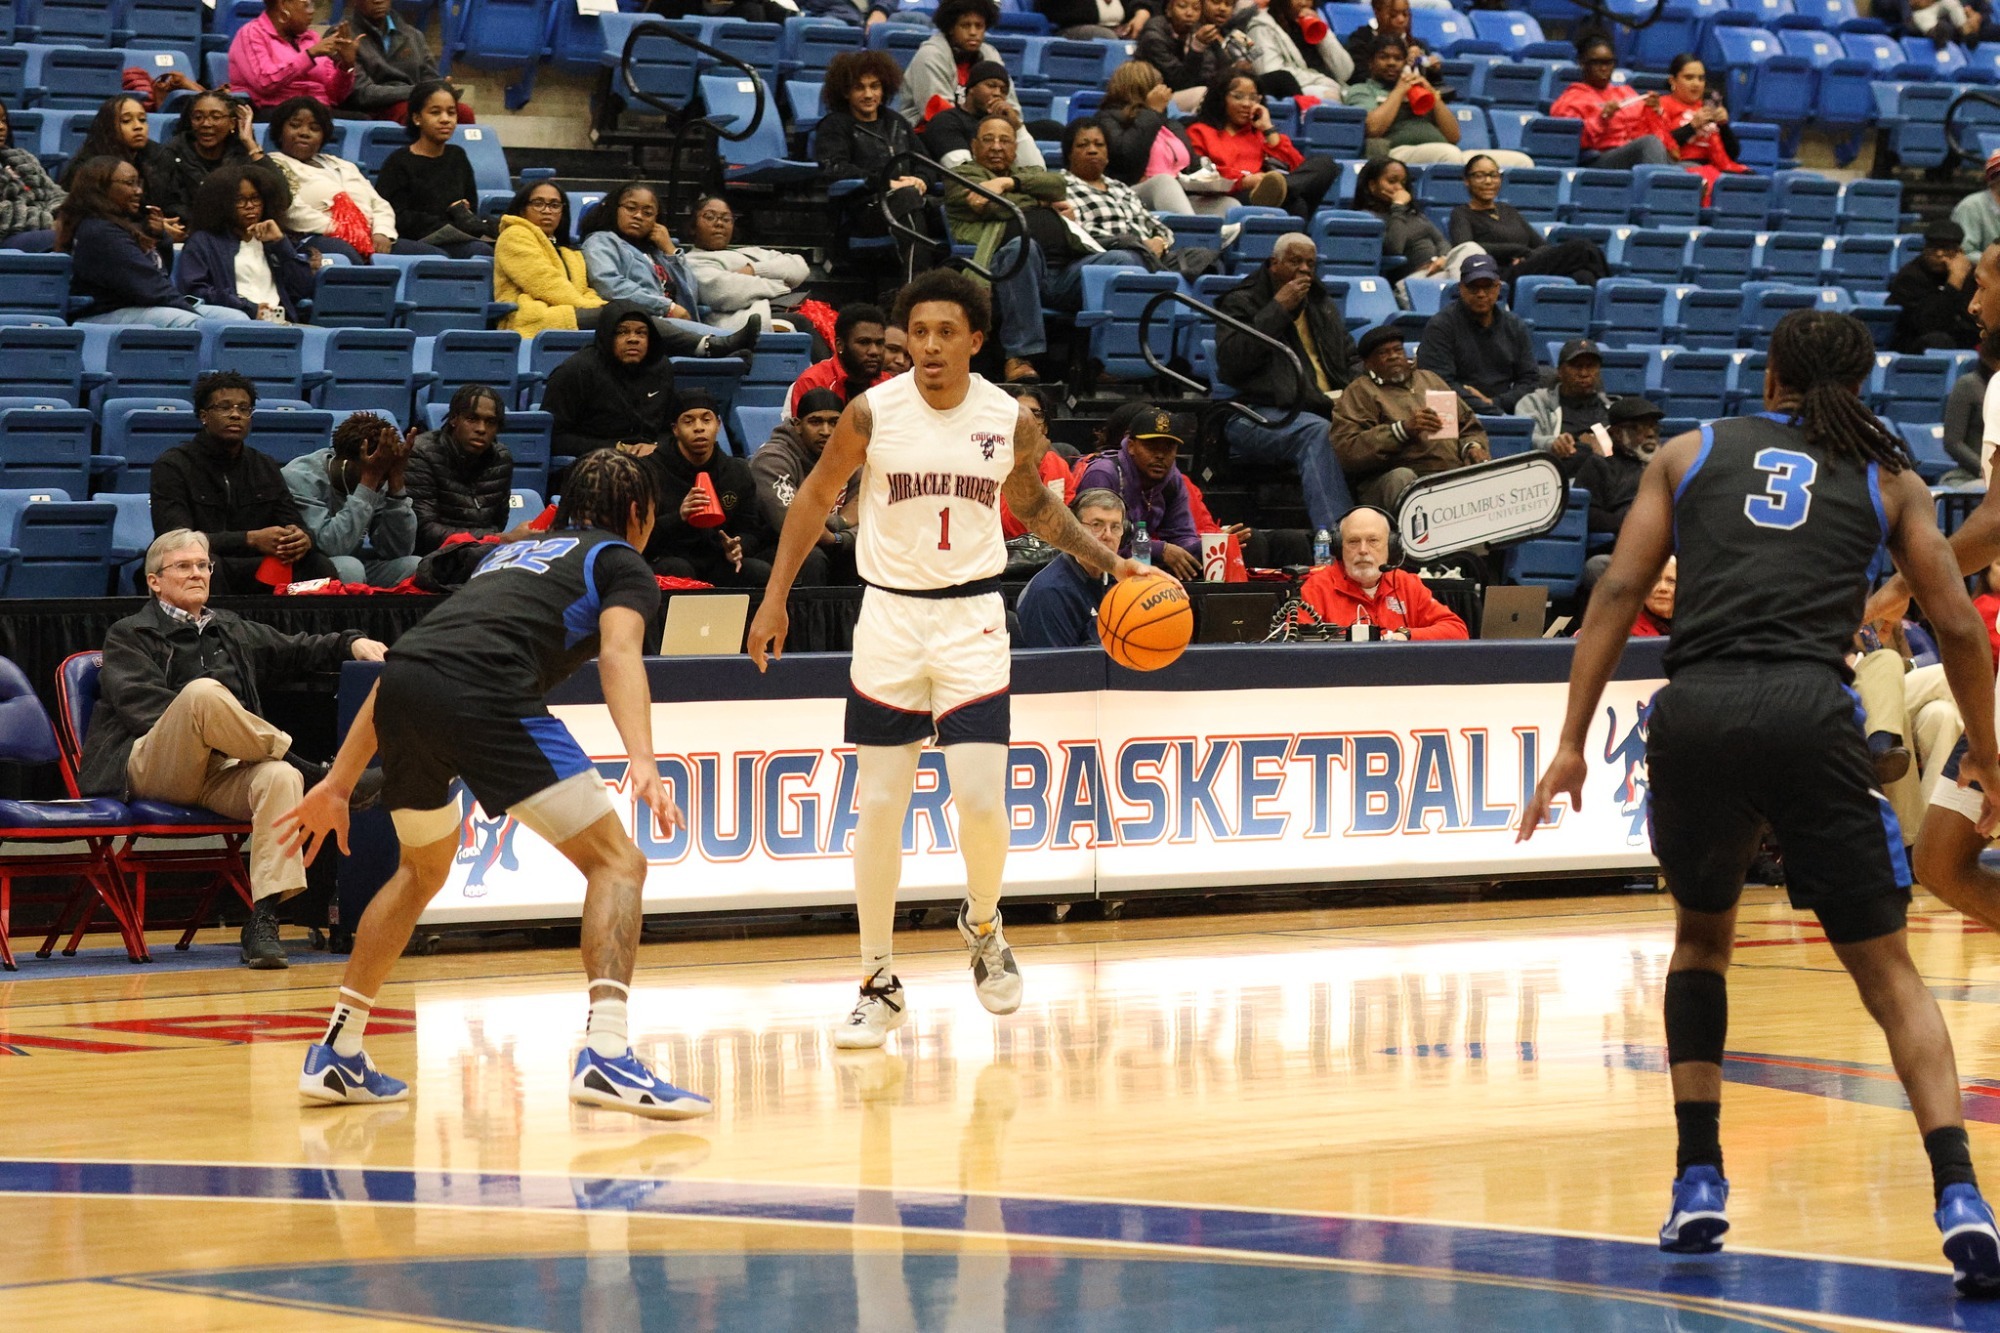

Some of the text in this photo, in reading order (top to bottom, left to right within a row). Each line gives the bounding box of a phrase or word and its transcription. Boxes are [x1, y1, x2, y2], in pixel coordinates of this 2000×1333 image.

[971, 432, 1005, 446] COUGARS
[886, 472, 950, 506] MIRACLE
[1432, 482, 1550, 524] COLUMBUS STATE
[1744, 447, 1818, 530] 3
[938, 507, 950, 550] 1
[1488, 498, 1550, 521] UNIVERSITY
[471, 538, 580, 579] 22
[587, 727, 1567, 866] OUGAR BASKETBALL
